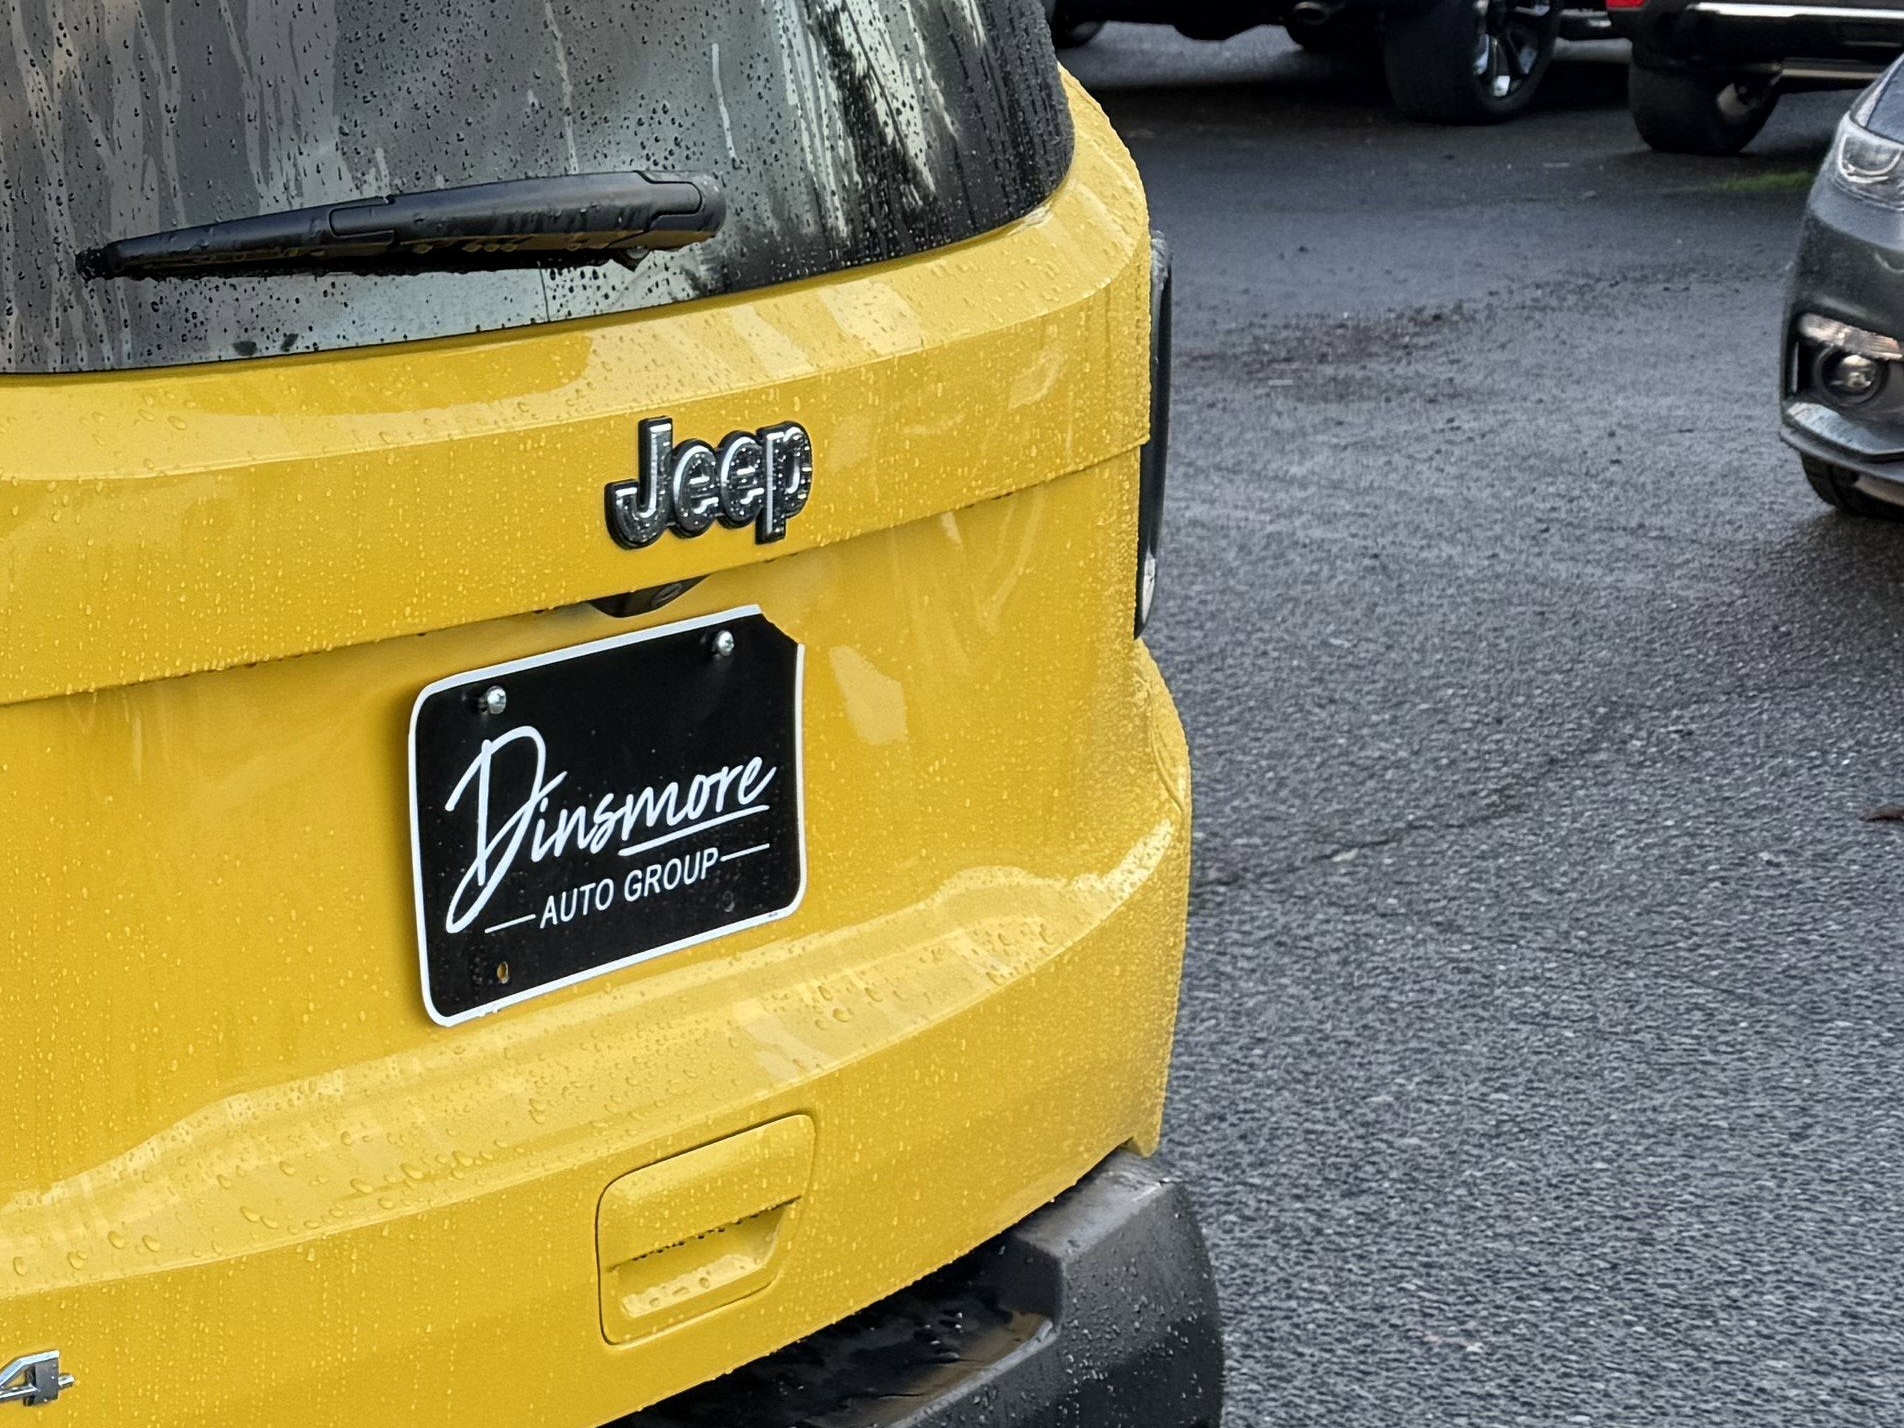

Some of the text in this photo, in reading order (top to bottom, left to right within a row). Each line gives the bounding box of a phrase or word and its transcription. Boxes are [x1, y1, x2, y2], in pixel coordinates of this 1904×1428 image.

[604, 415, 813, 550] Jeep
[444, 726, 777, 933] Dinsmore
[540, 847, 719, 928] AUTO GROUP
